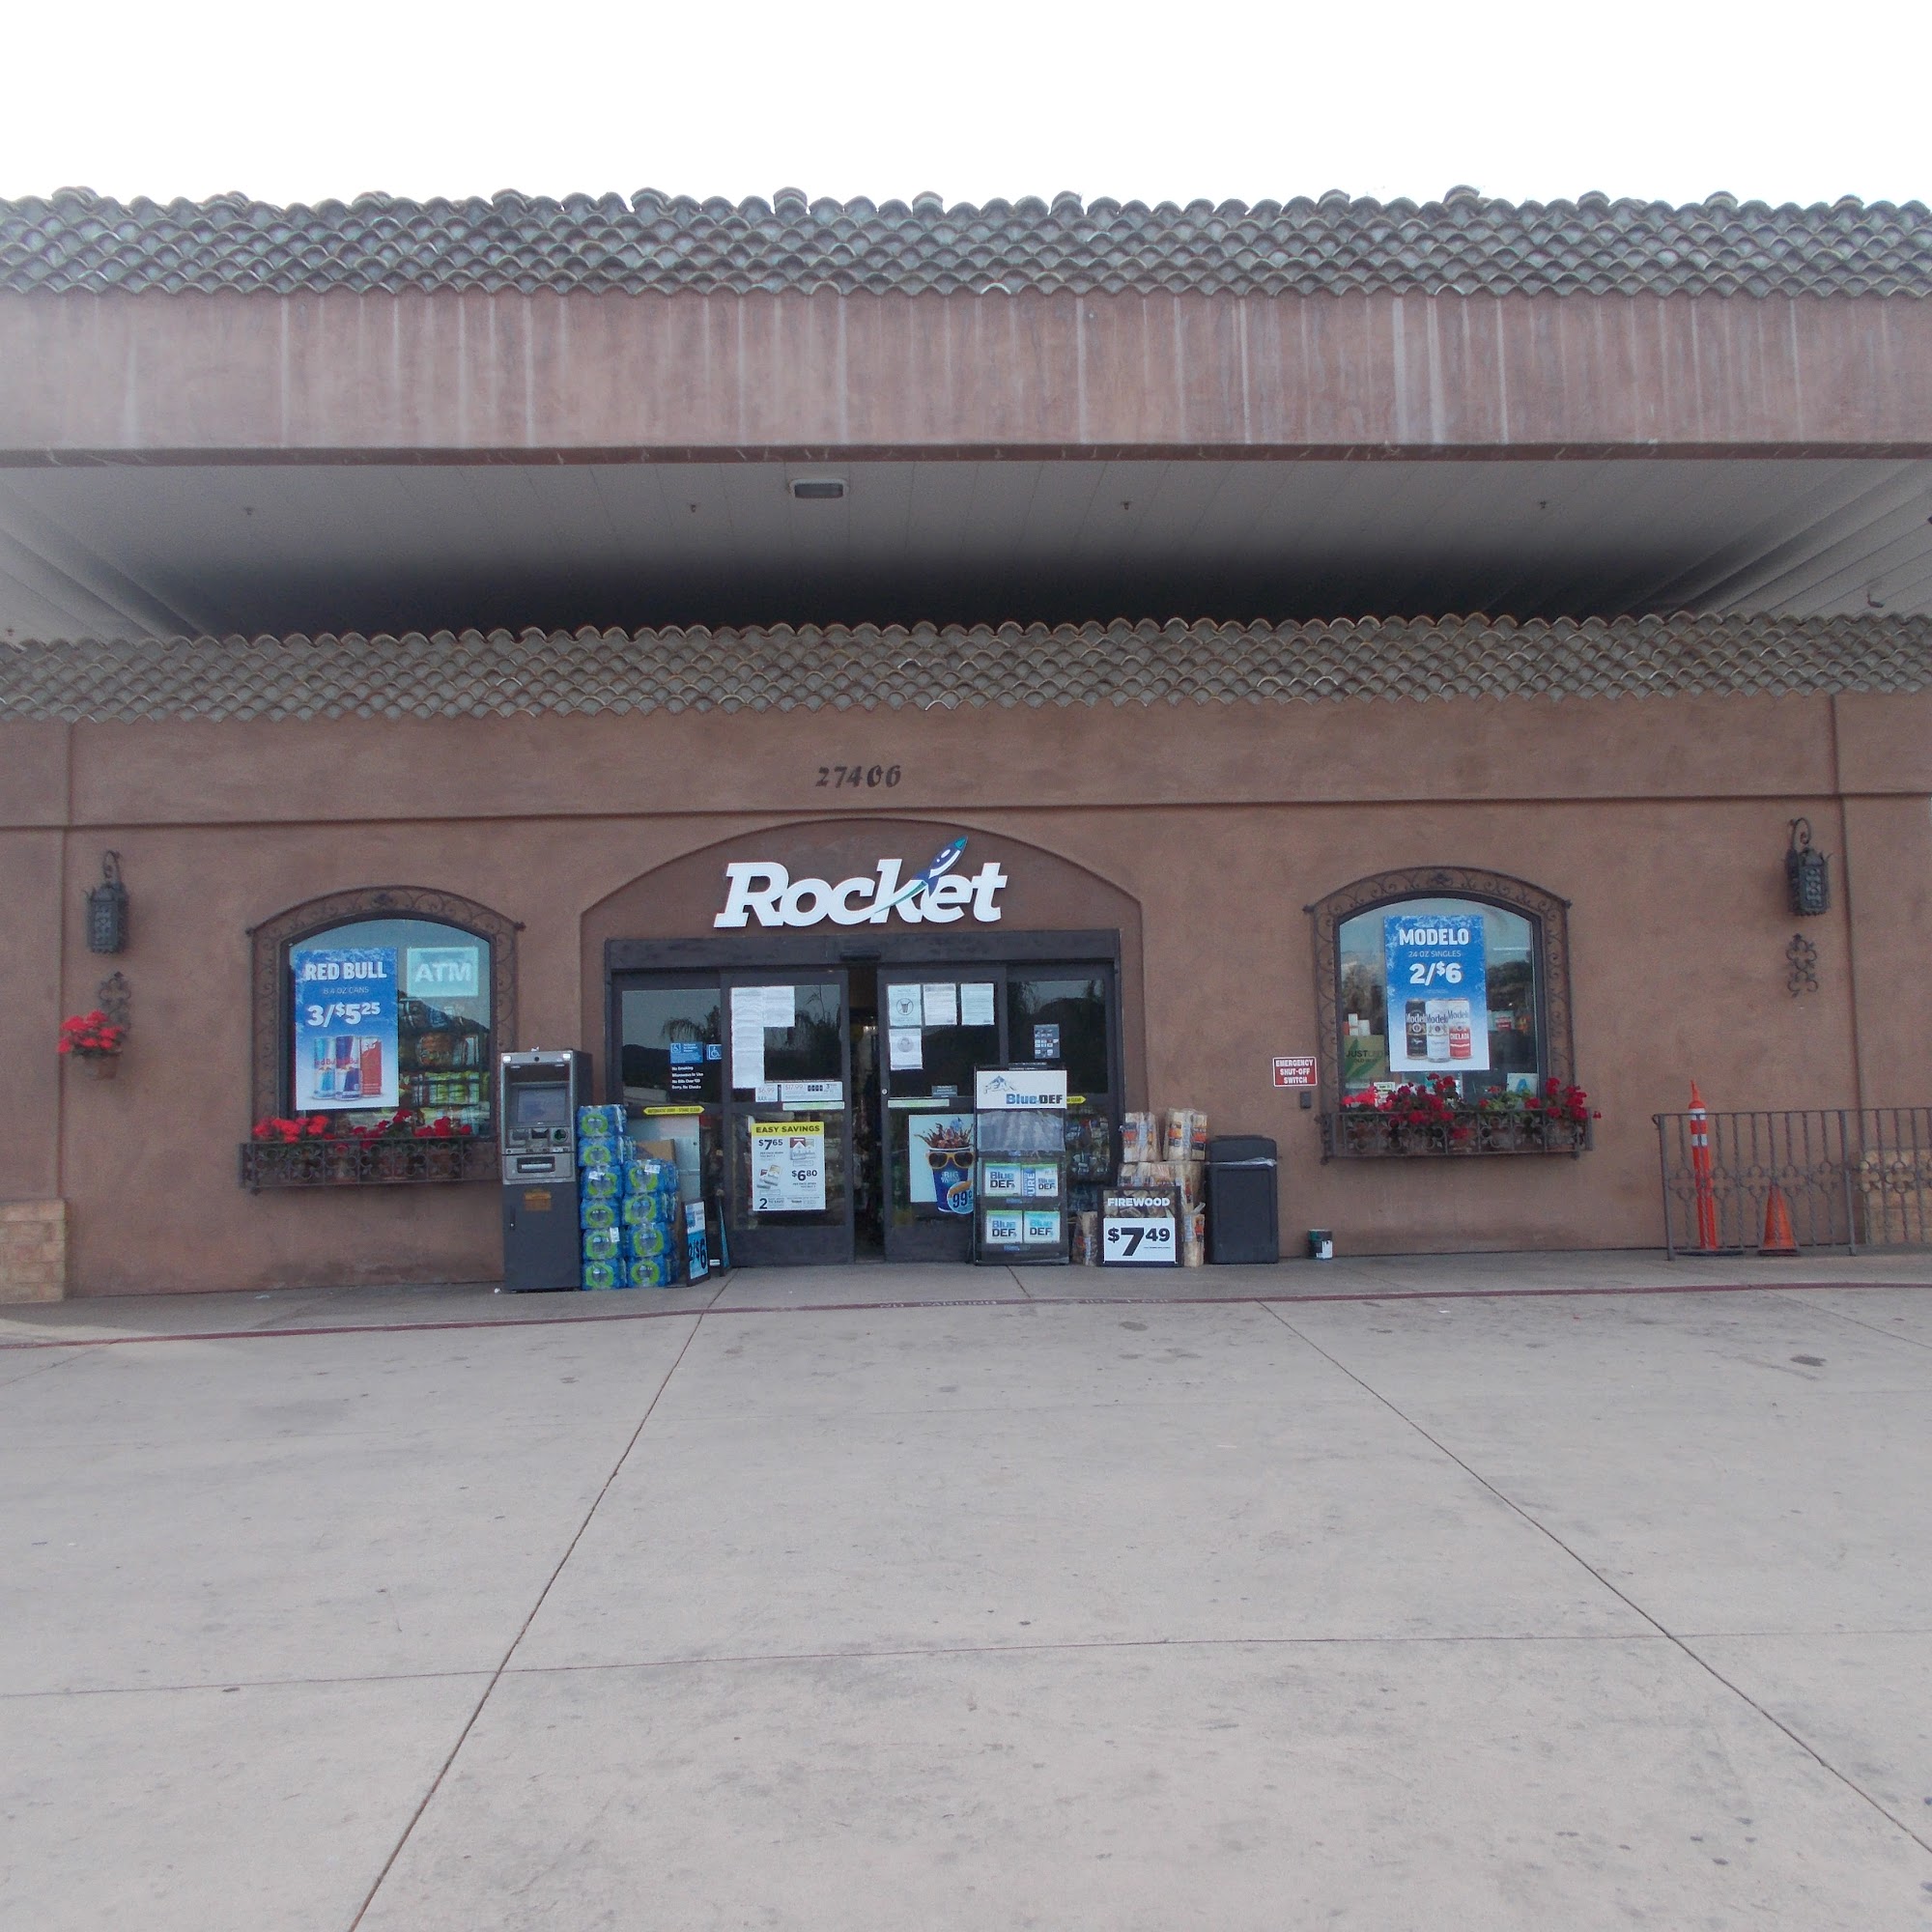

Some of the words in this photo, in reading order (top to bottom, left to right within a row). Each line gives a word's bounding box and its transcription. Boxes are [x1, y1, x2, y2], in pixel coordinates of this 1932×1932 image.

[816, 764, 901, 788] 27406
[714, 859, 1008, 928] Rocket
[1400, 928, 1470, 946] MODELO
[305, 963, 340, 981] RED
[343, 961, 387, 980] BULL
[414, 962, 473, 982] ATM
[1409, 961, 1463, 986] 2/$6
[1275, 1059, 1314, 1067] EMERGENCY
[1280, 1067, 1310, 1076] SHUT-OFF
[781, 1124, 821, 1133] SAVINGS
[990, 1171, 1014, 1179] Blue
[759, 1198, 768, 1209] 2
[1107, 1197, 1171, 1207] FIREWOOD
[992, 1228, 1015, 1237] DEF
[1030, 1227, 1052, 1236] DEF
